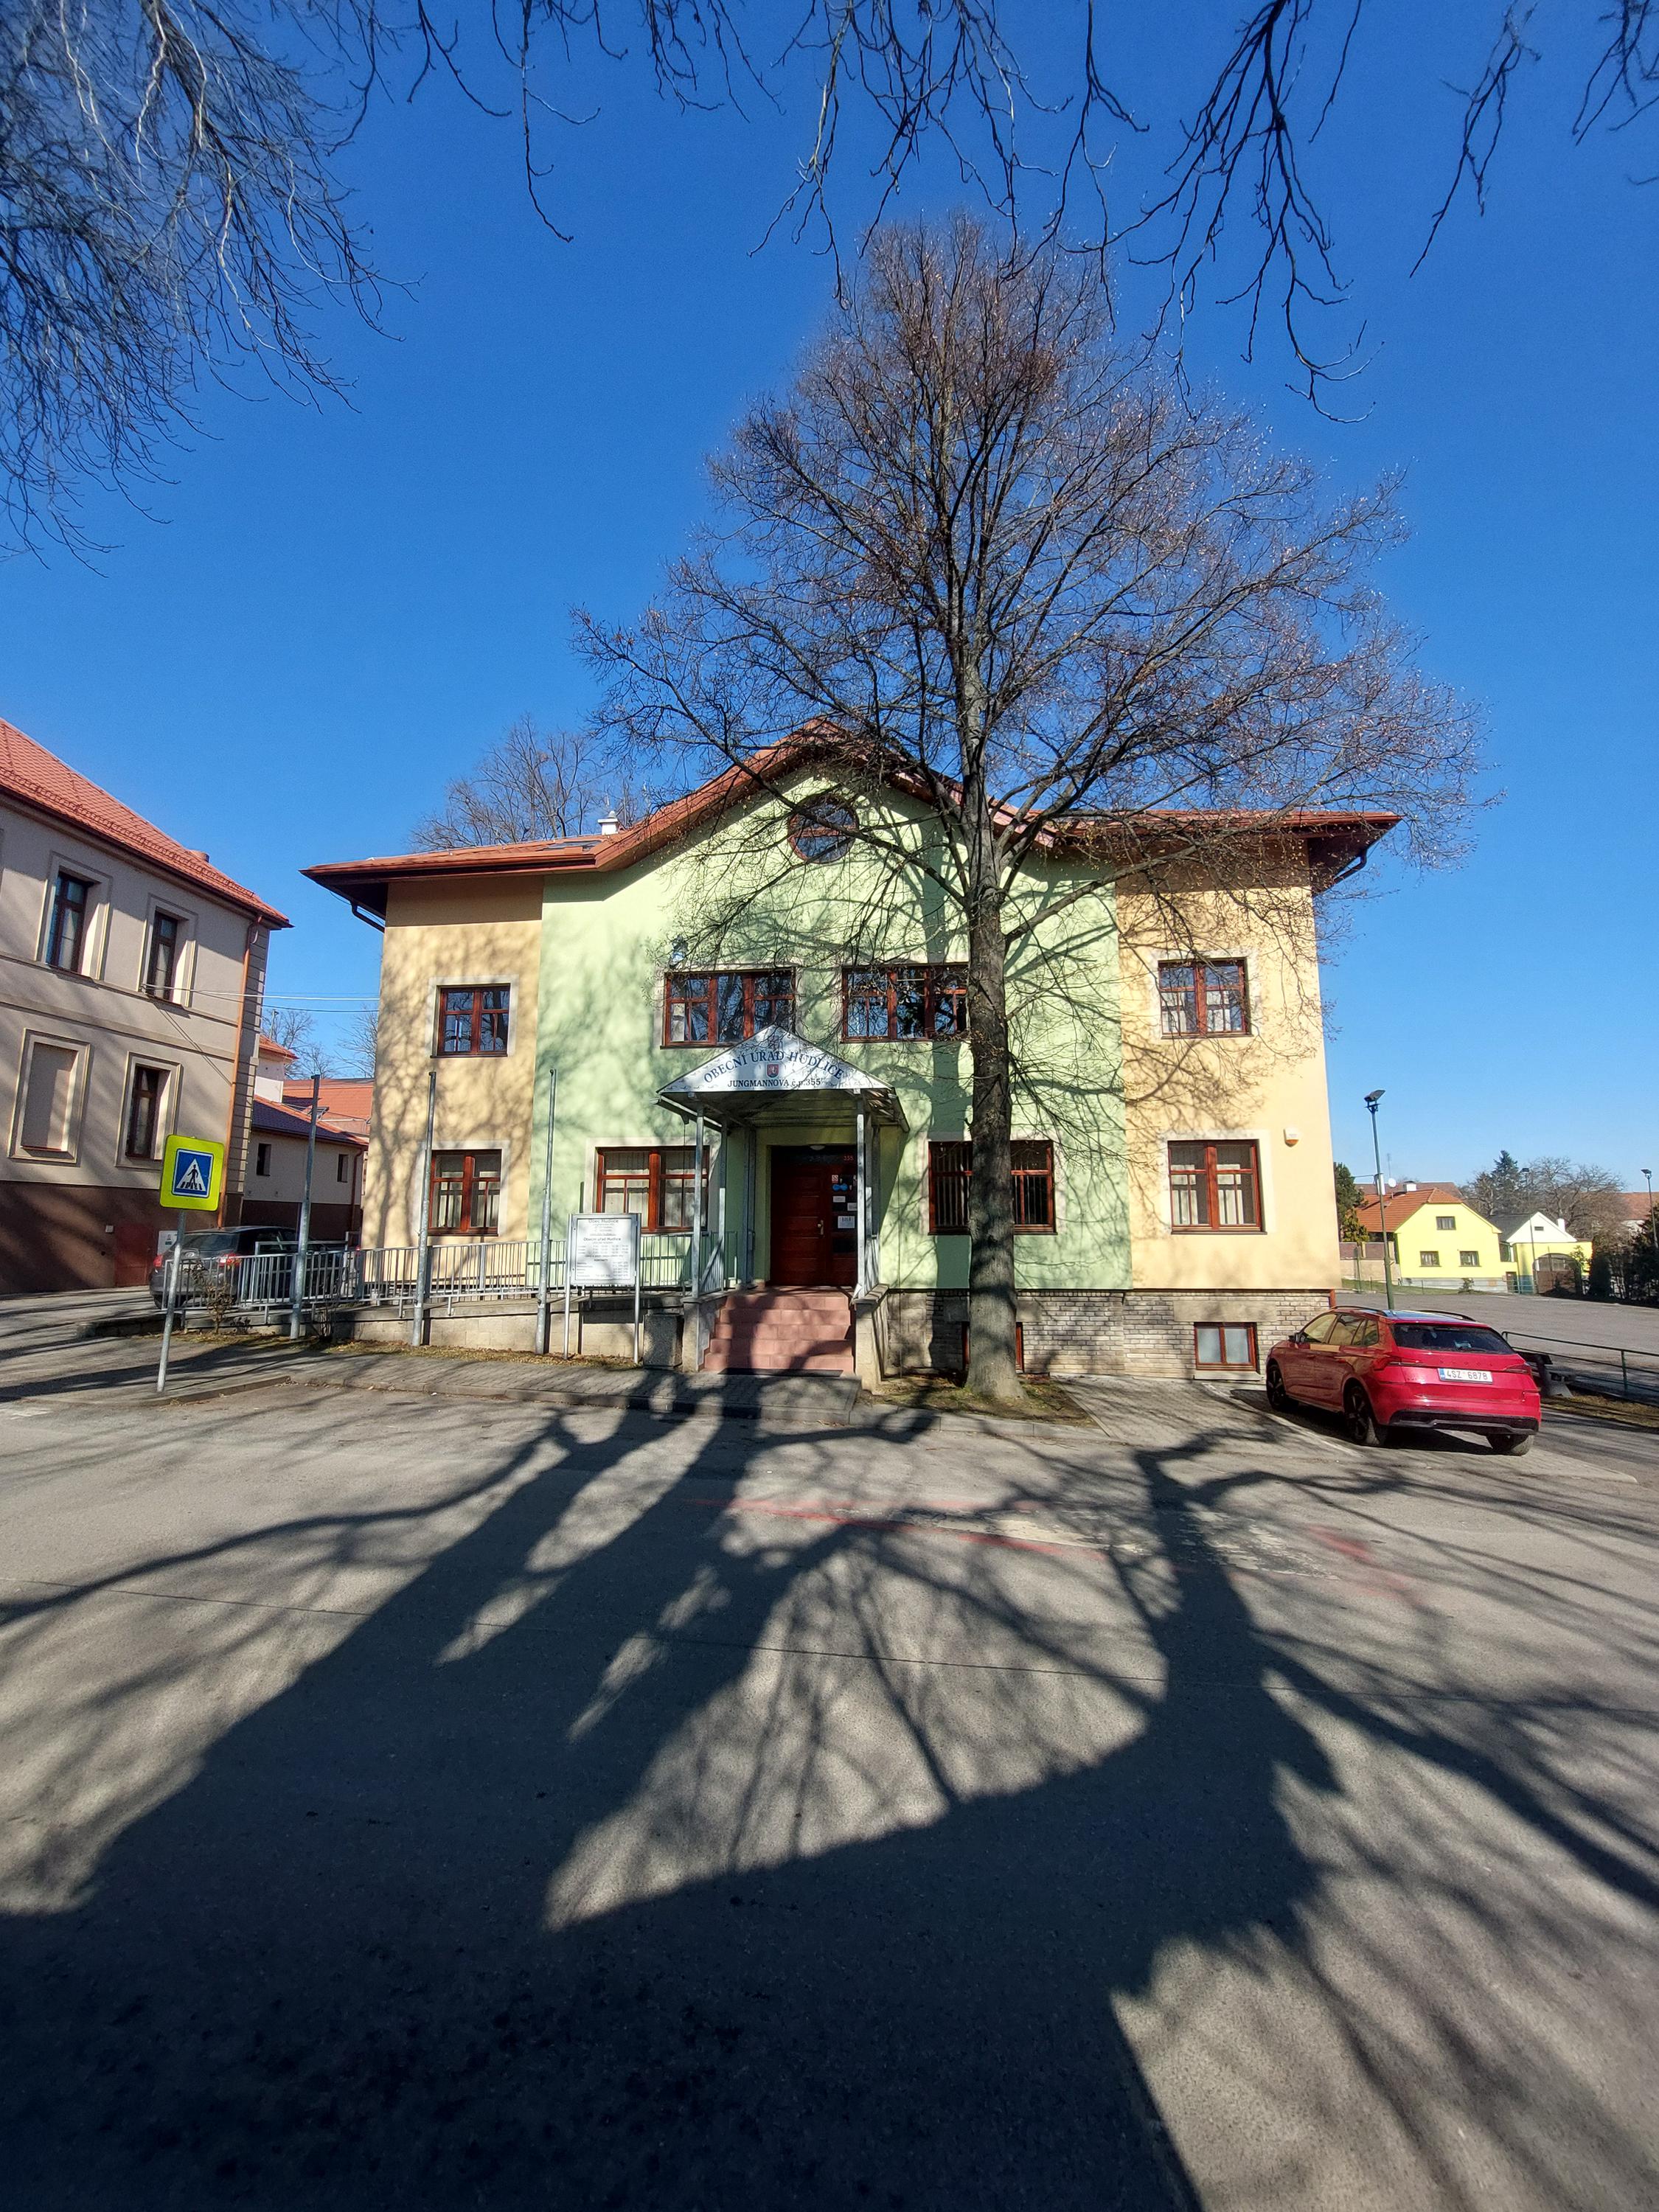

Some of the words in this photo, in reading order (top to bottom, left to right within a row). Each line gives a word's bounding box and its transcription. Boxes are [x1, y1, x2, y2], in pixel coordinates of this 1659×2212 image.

[704, 1052, 748, 1083] OBECNÍ
[790, 1051, 845, 1080] HUDLICE
[728, 1079, 790, 1088] JUNGMANNOVA
[1447, 1370, 1462, 1379] 4SZ
